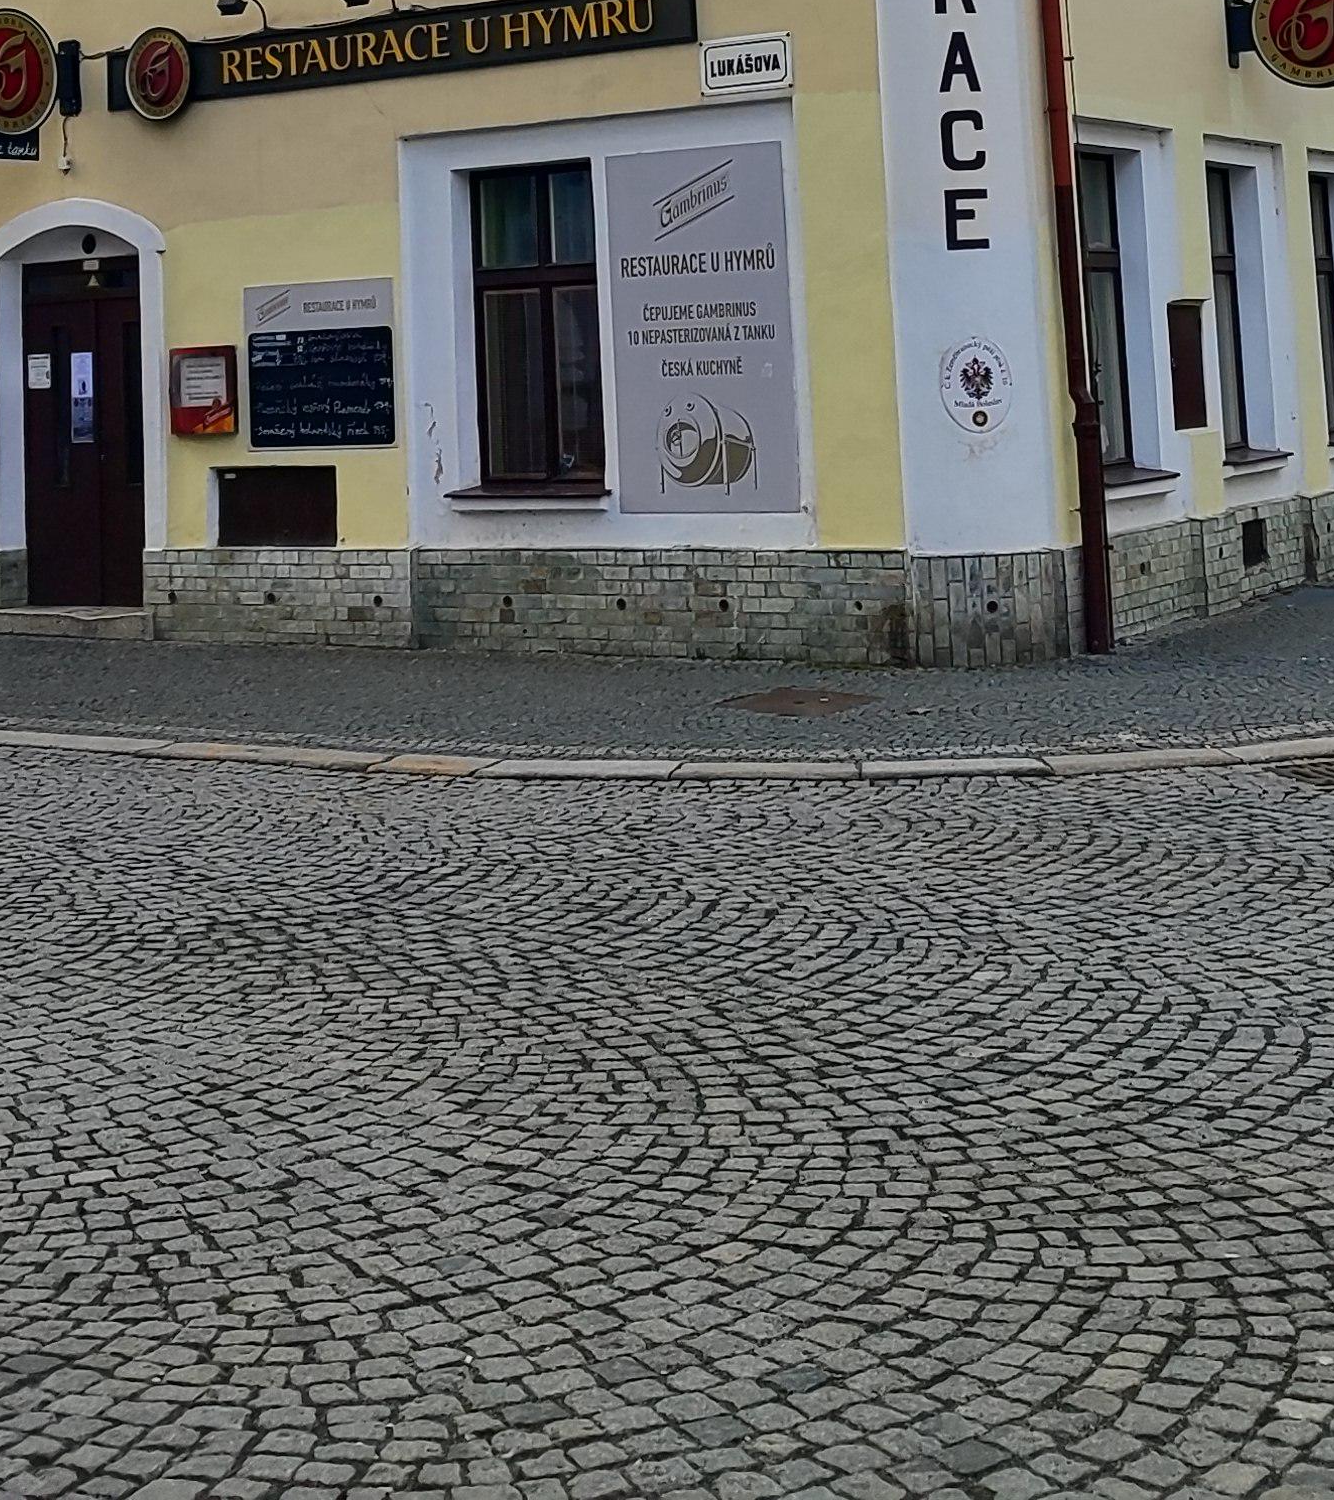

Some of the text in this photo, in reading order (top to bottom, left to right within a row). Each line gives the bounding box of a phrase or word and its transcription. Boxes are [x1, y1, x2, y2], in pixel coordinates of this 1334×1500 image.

[220, 21, 450, 85] RESTAURACE
[465, 16, 489, 54] U
[710, 53, 781, 78] LUKÁŠOVA
[659, 175, 729, 228] Gambrinus
[620, 242, 775, 279] RESTAURACE U HYMRŮ
[643, 300, 757, 322] ČEPUJEME GAMBRINUS
[627, 324, 775, 346] 10 NEPASTERIZOVANÁ Z TANKU
[661, 355, 744, 378] ČESKÁ KUCHYNĚ
